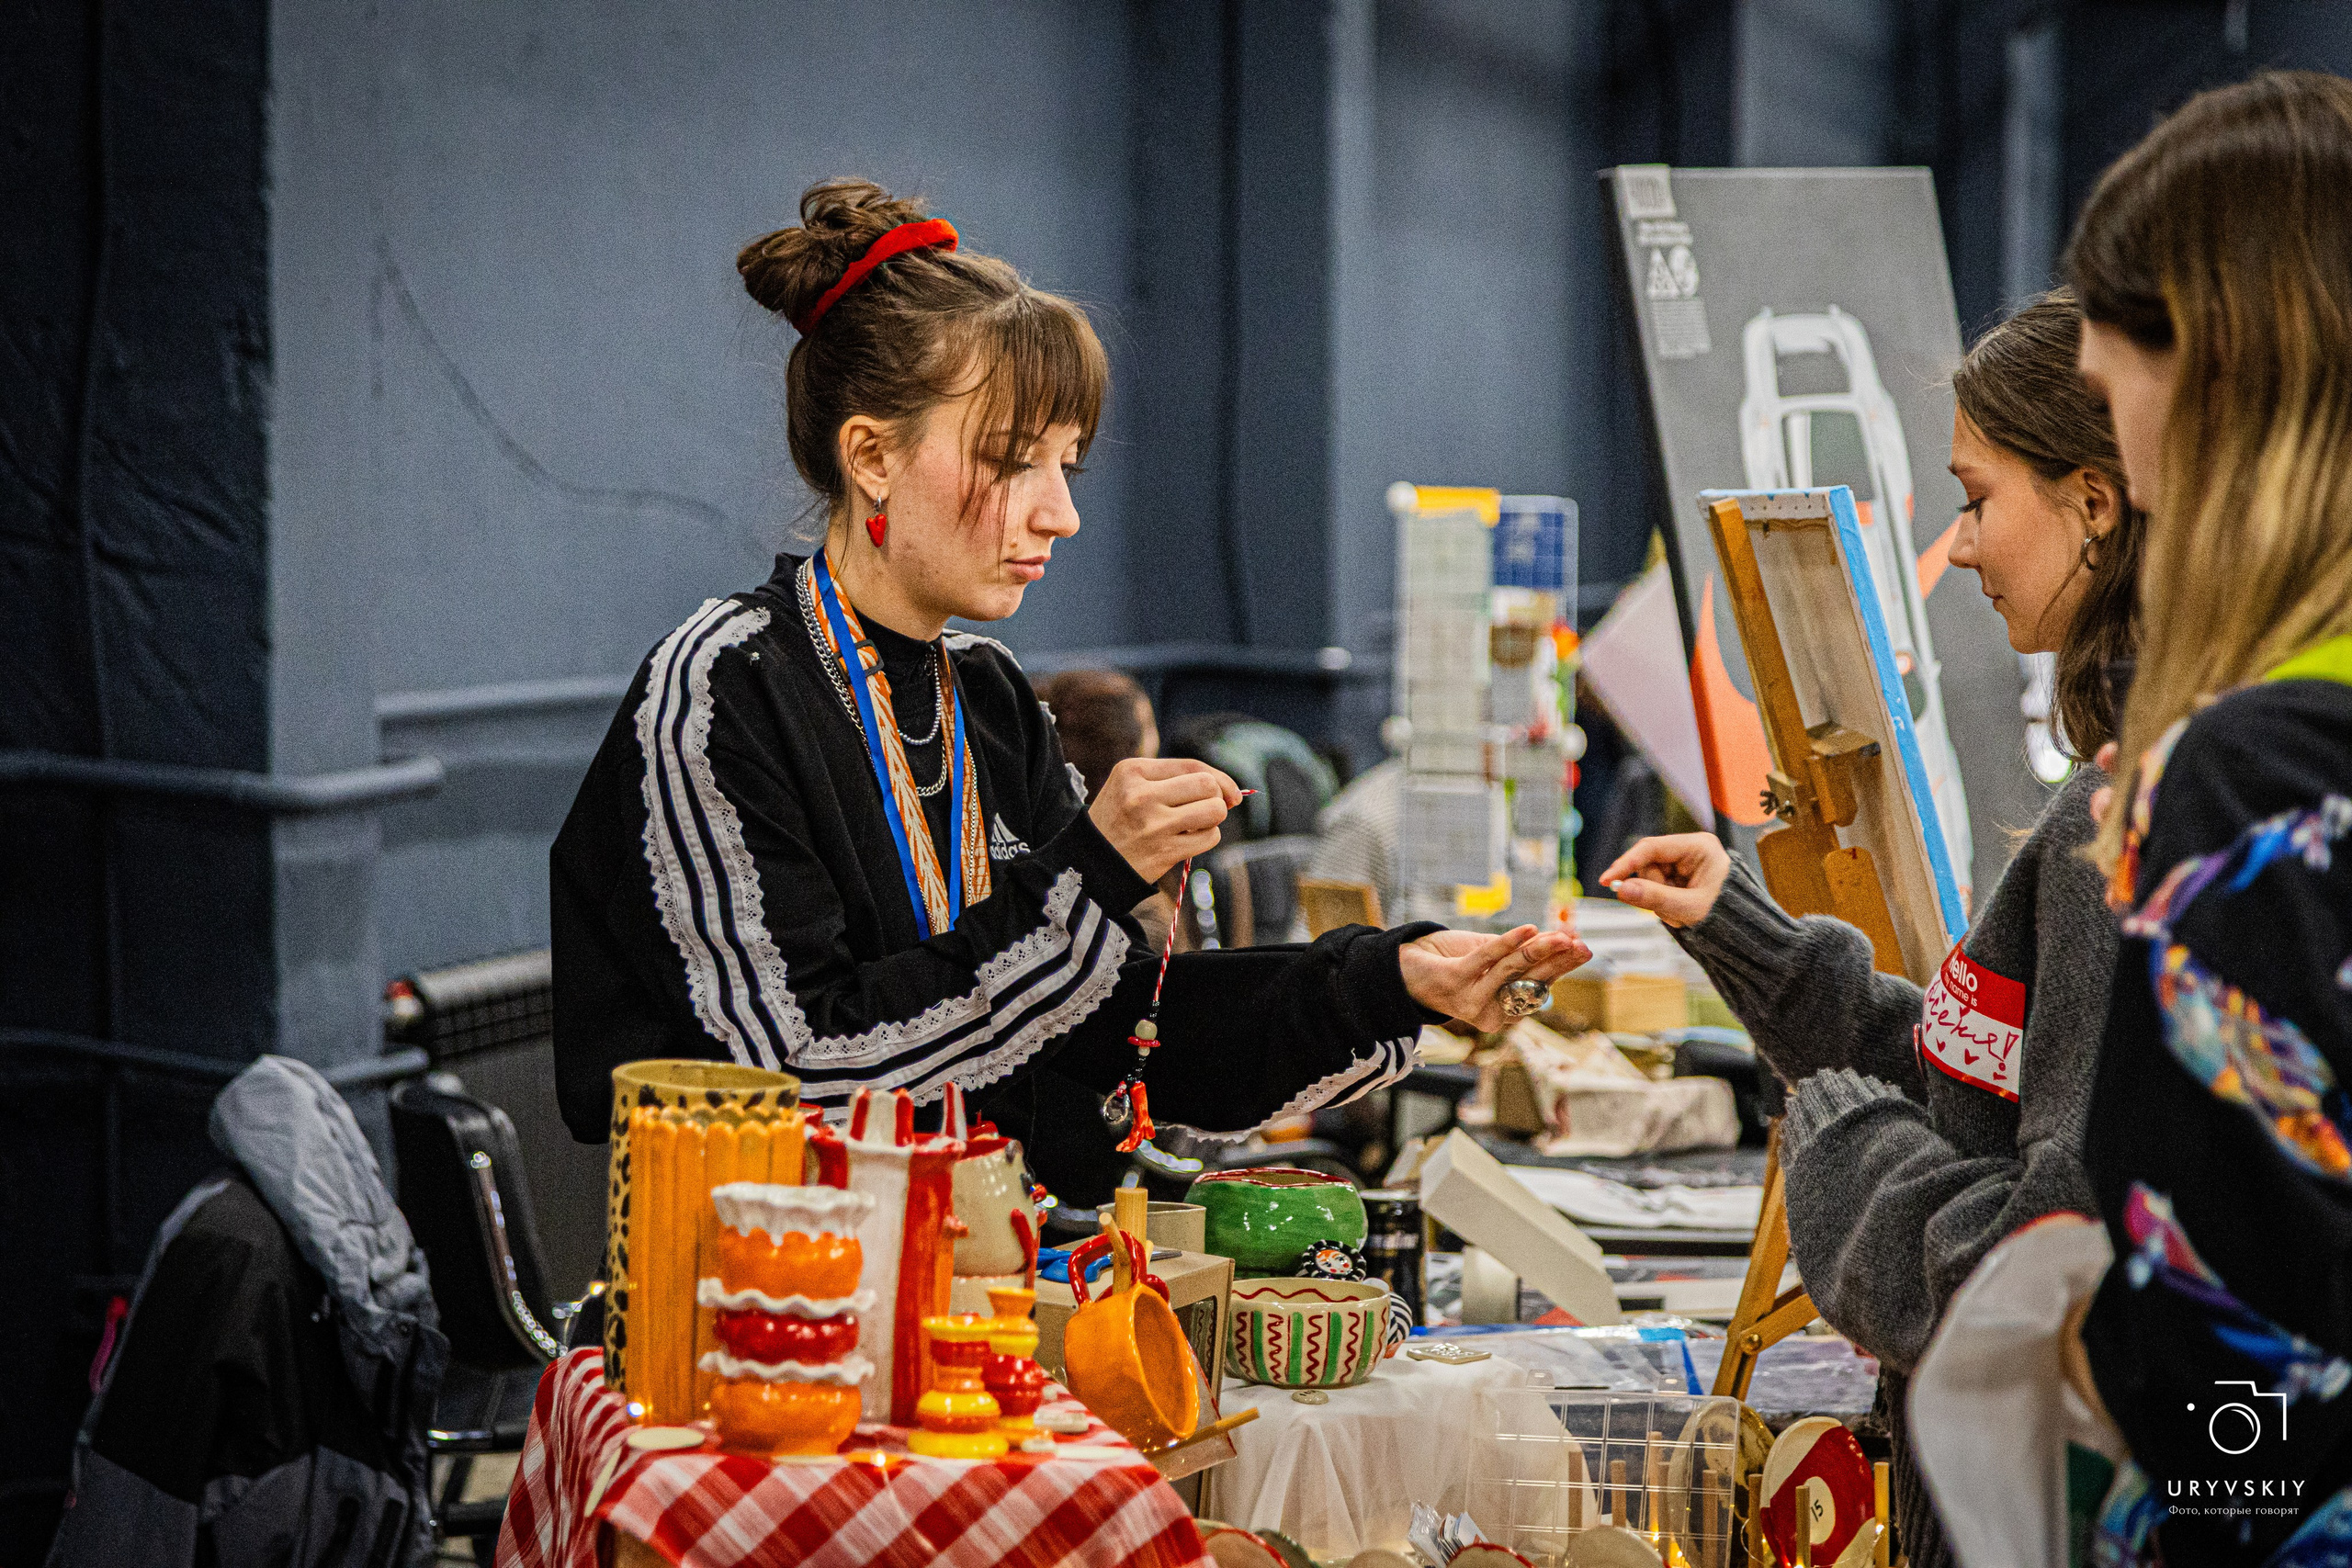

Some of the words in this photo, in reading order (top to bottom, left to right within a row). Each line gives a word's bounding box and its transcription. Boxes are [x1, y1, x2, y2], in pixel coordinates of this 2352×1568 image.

[990, 841, 1031, 860] adidas
[1949, 980, 1969, 1002] name
[1971, 995, 1978, 1007] is
[1811, 1499, 1823, 1522] 15
